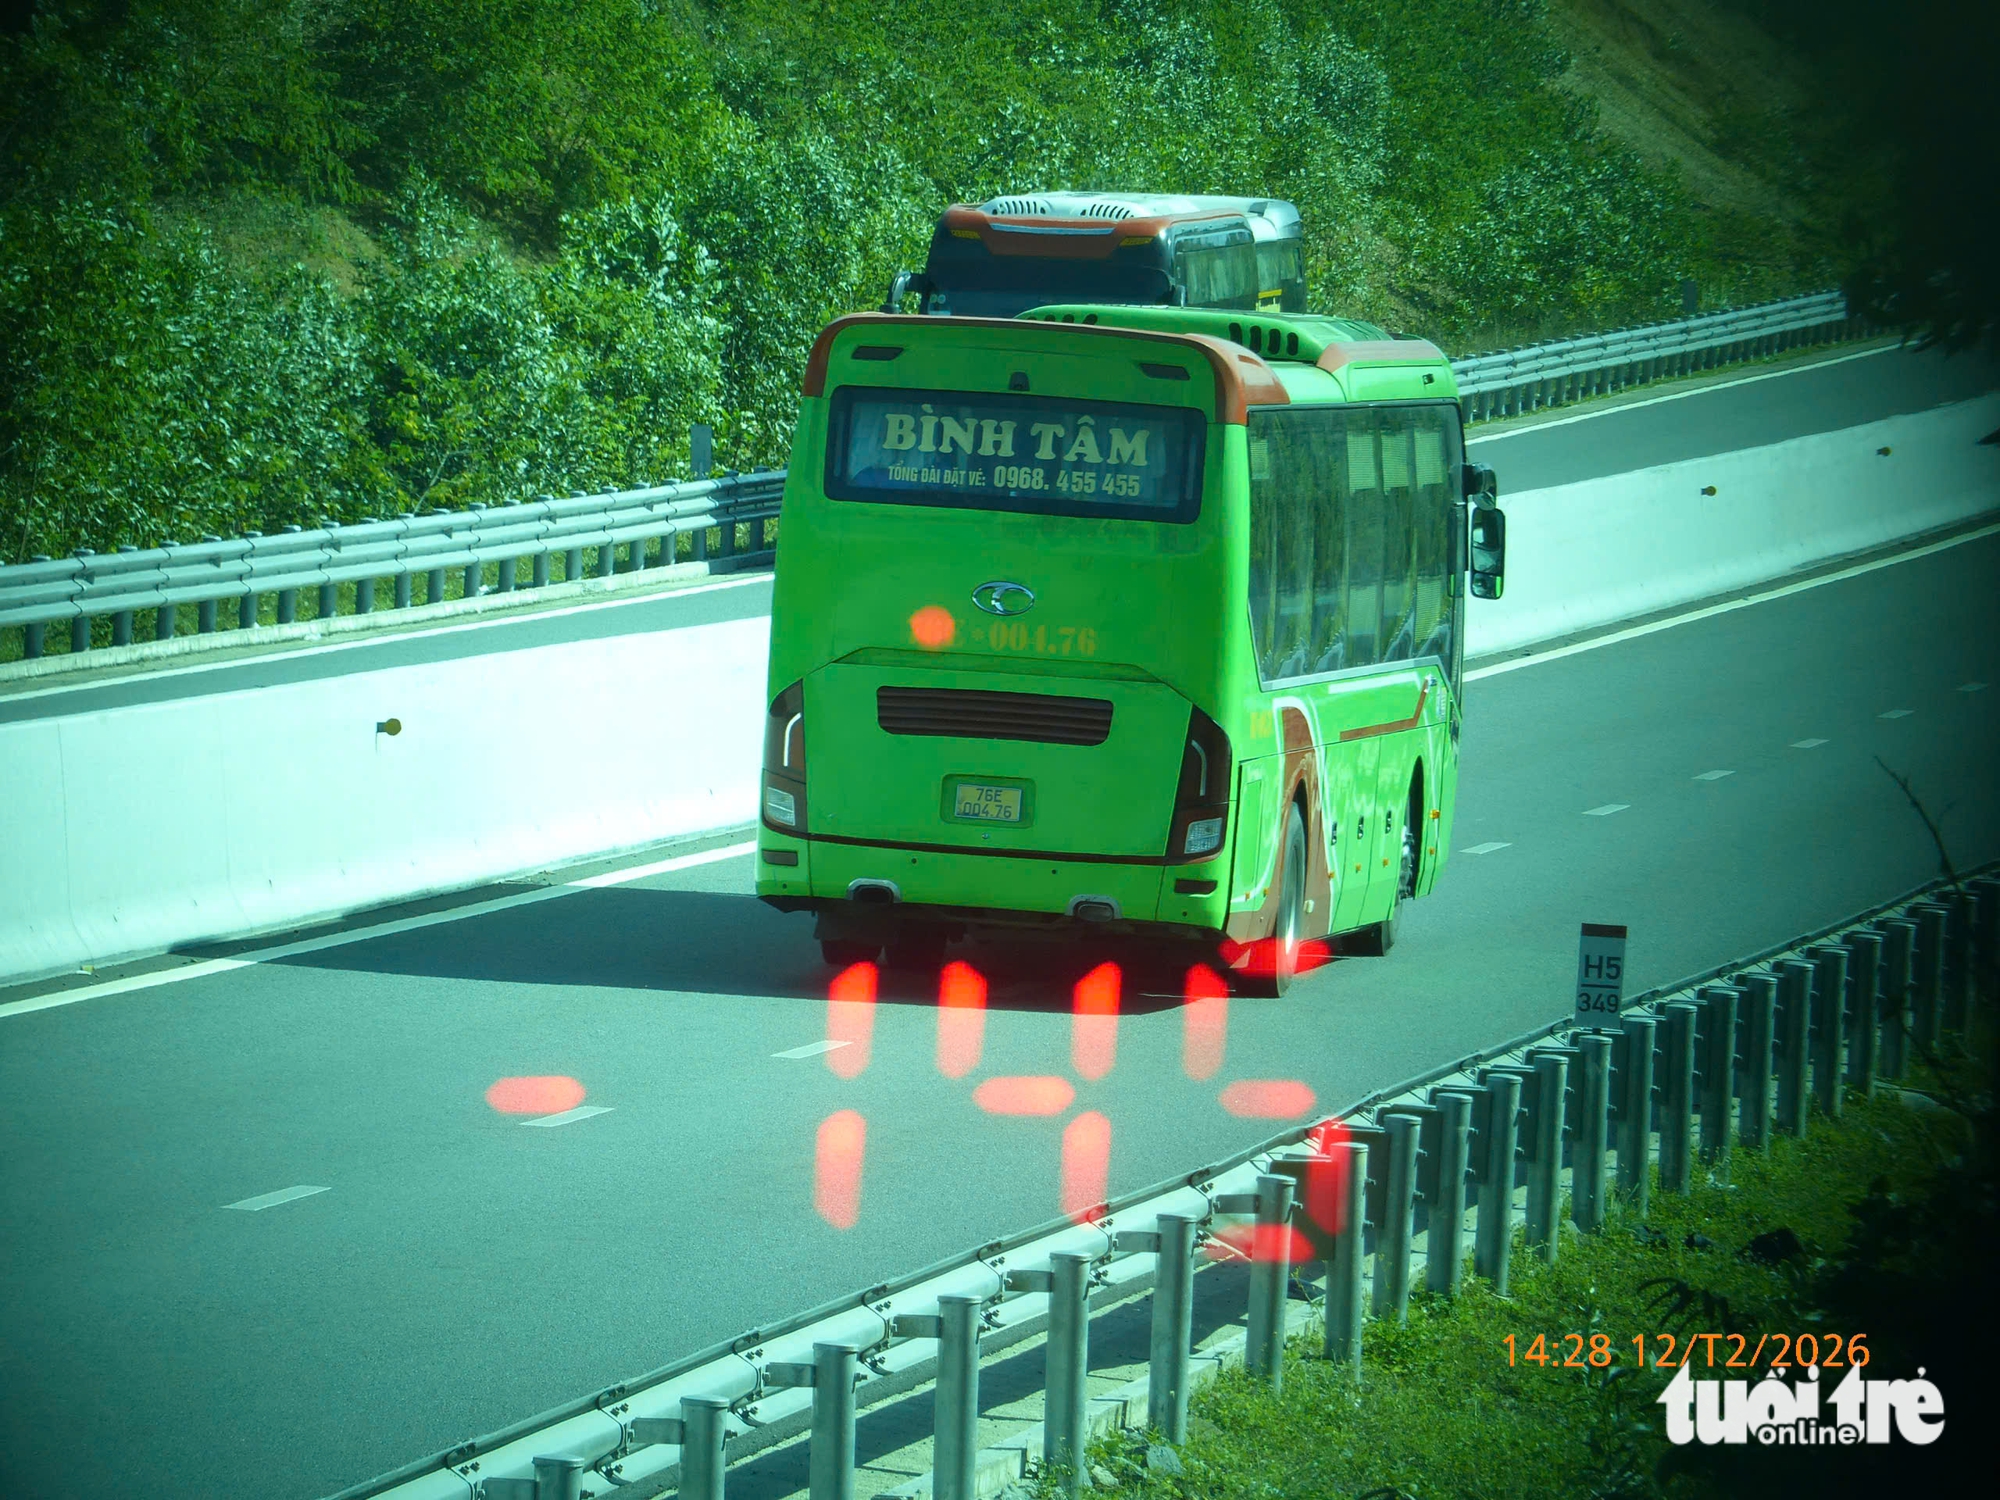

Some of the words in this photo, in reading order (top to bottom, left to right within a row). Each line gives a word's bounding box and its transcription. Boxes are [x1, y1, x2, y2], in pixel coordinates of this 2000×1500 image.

[882, 403, 1017, 457] BÌNH
[1030, 414, 1150, 466] TÂM
[921, 465, 940, 484] ĐÀI
[943, 467, 966, 488] ĐẶT
[994, 466, 1049, 490] 0968.
[1056, 470, 1096, 494] 455
[1102, 474, 1140, 497] 455
[976, 788, 1003, 803] 76E
[963, 801, 1012, 818] 004.76
[1584, 954, 1621, 980] H5
[1578, 992, 1619, 1013] 349
